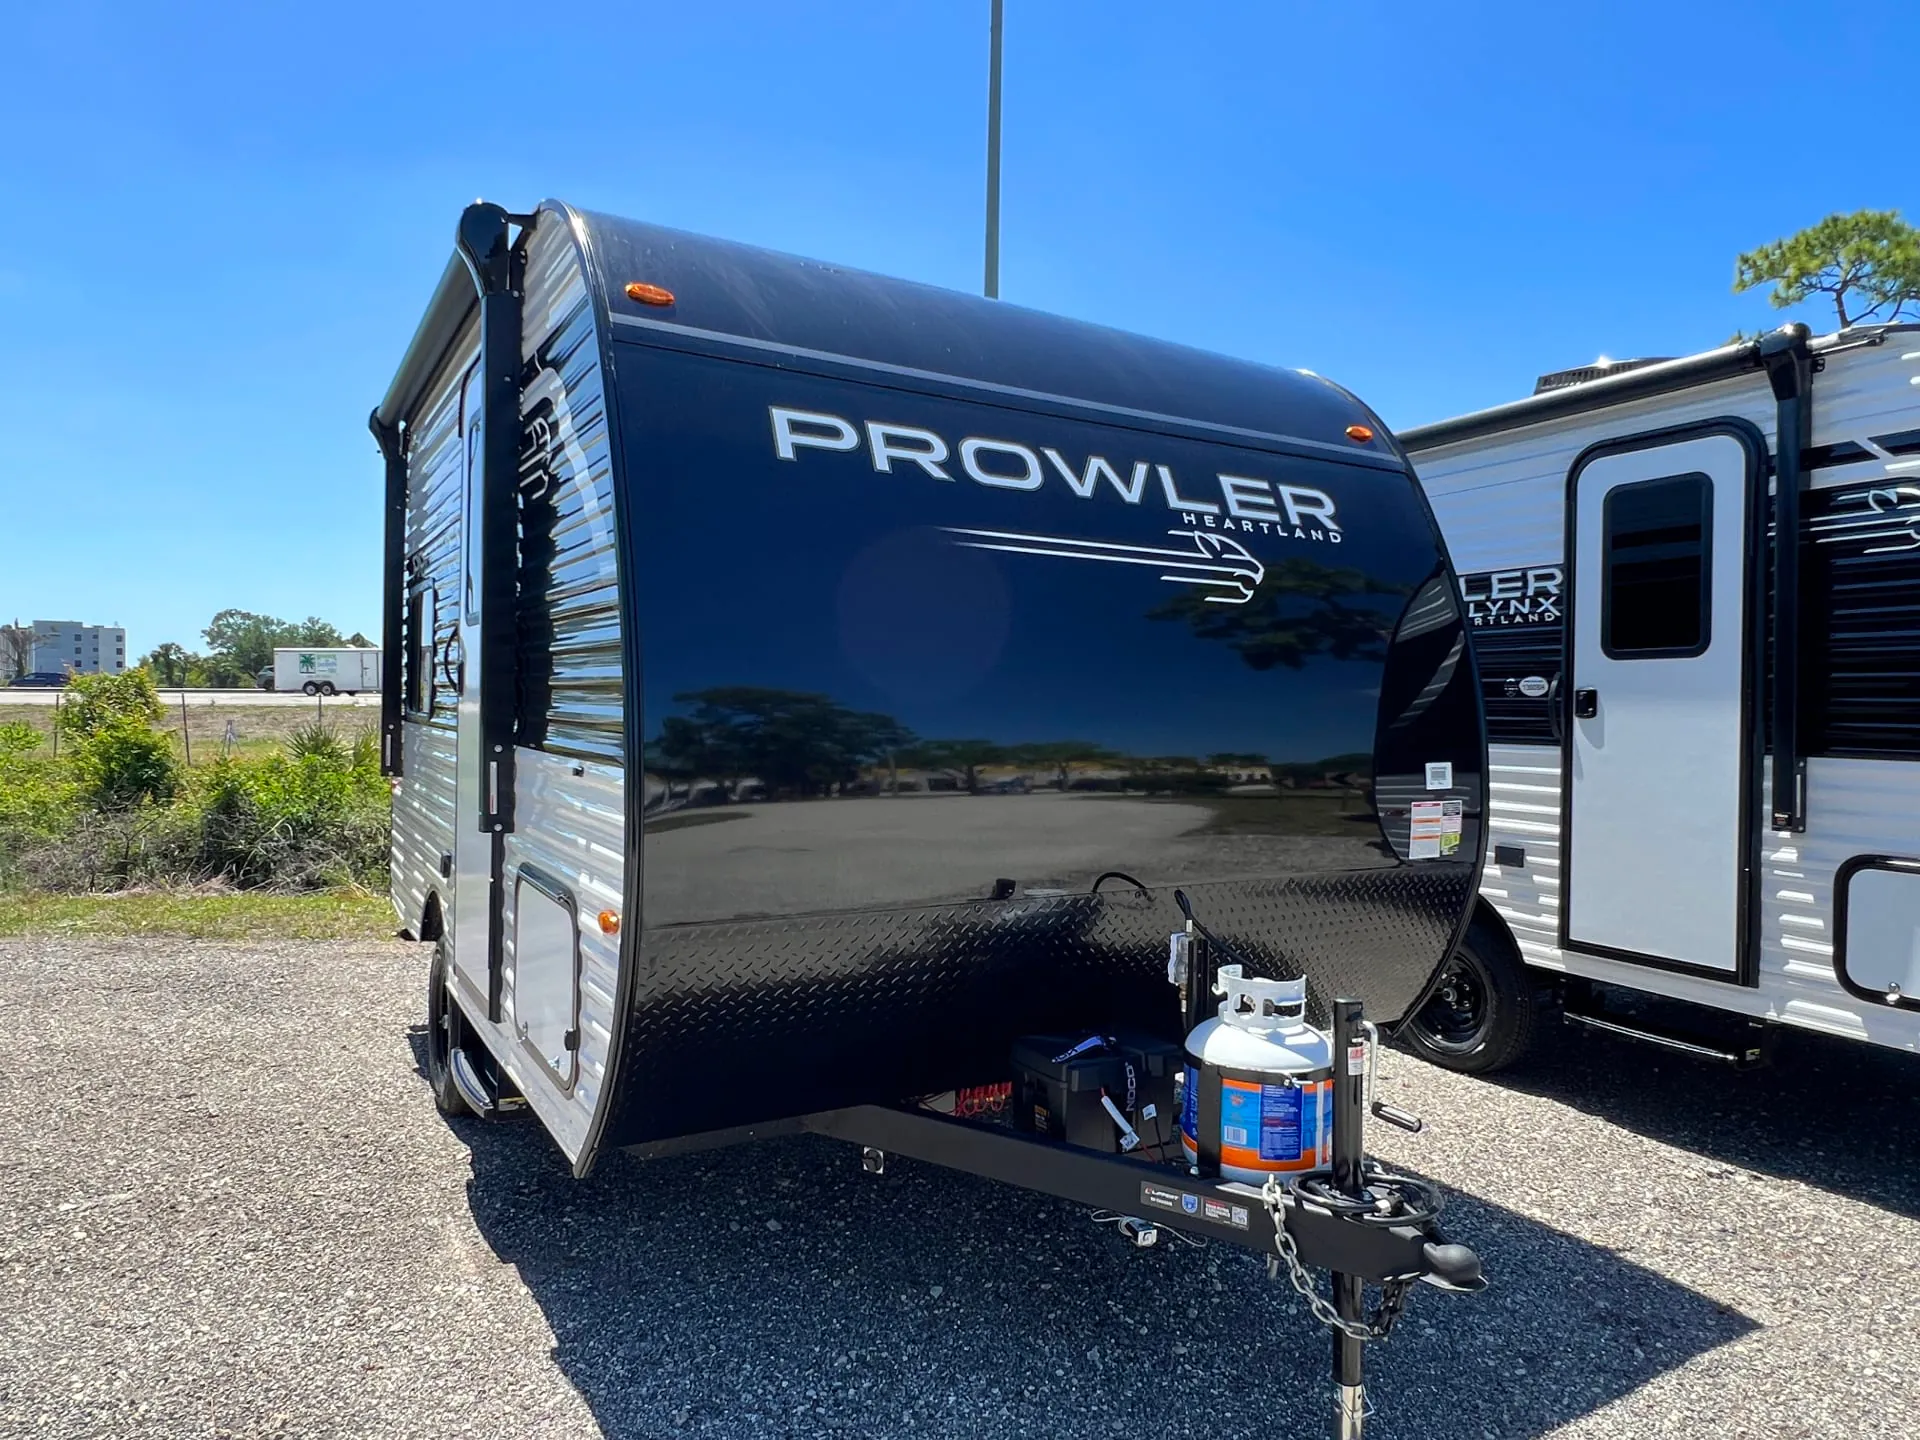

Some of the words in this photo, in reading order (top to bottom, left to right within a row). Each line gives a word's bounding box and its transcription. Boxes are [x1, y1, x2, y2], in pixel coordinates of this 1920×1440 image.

[769, 405, 1343, 532] PROWLER
[1183, 512, 1343, 544] HEARTLAND
[1468, 596, 1562, 618] LYNX
[1474, 612, 1555, 626] RTLAND
